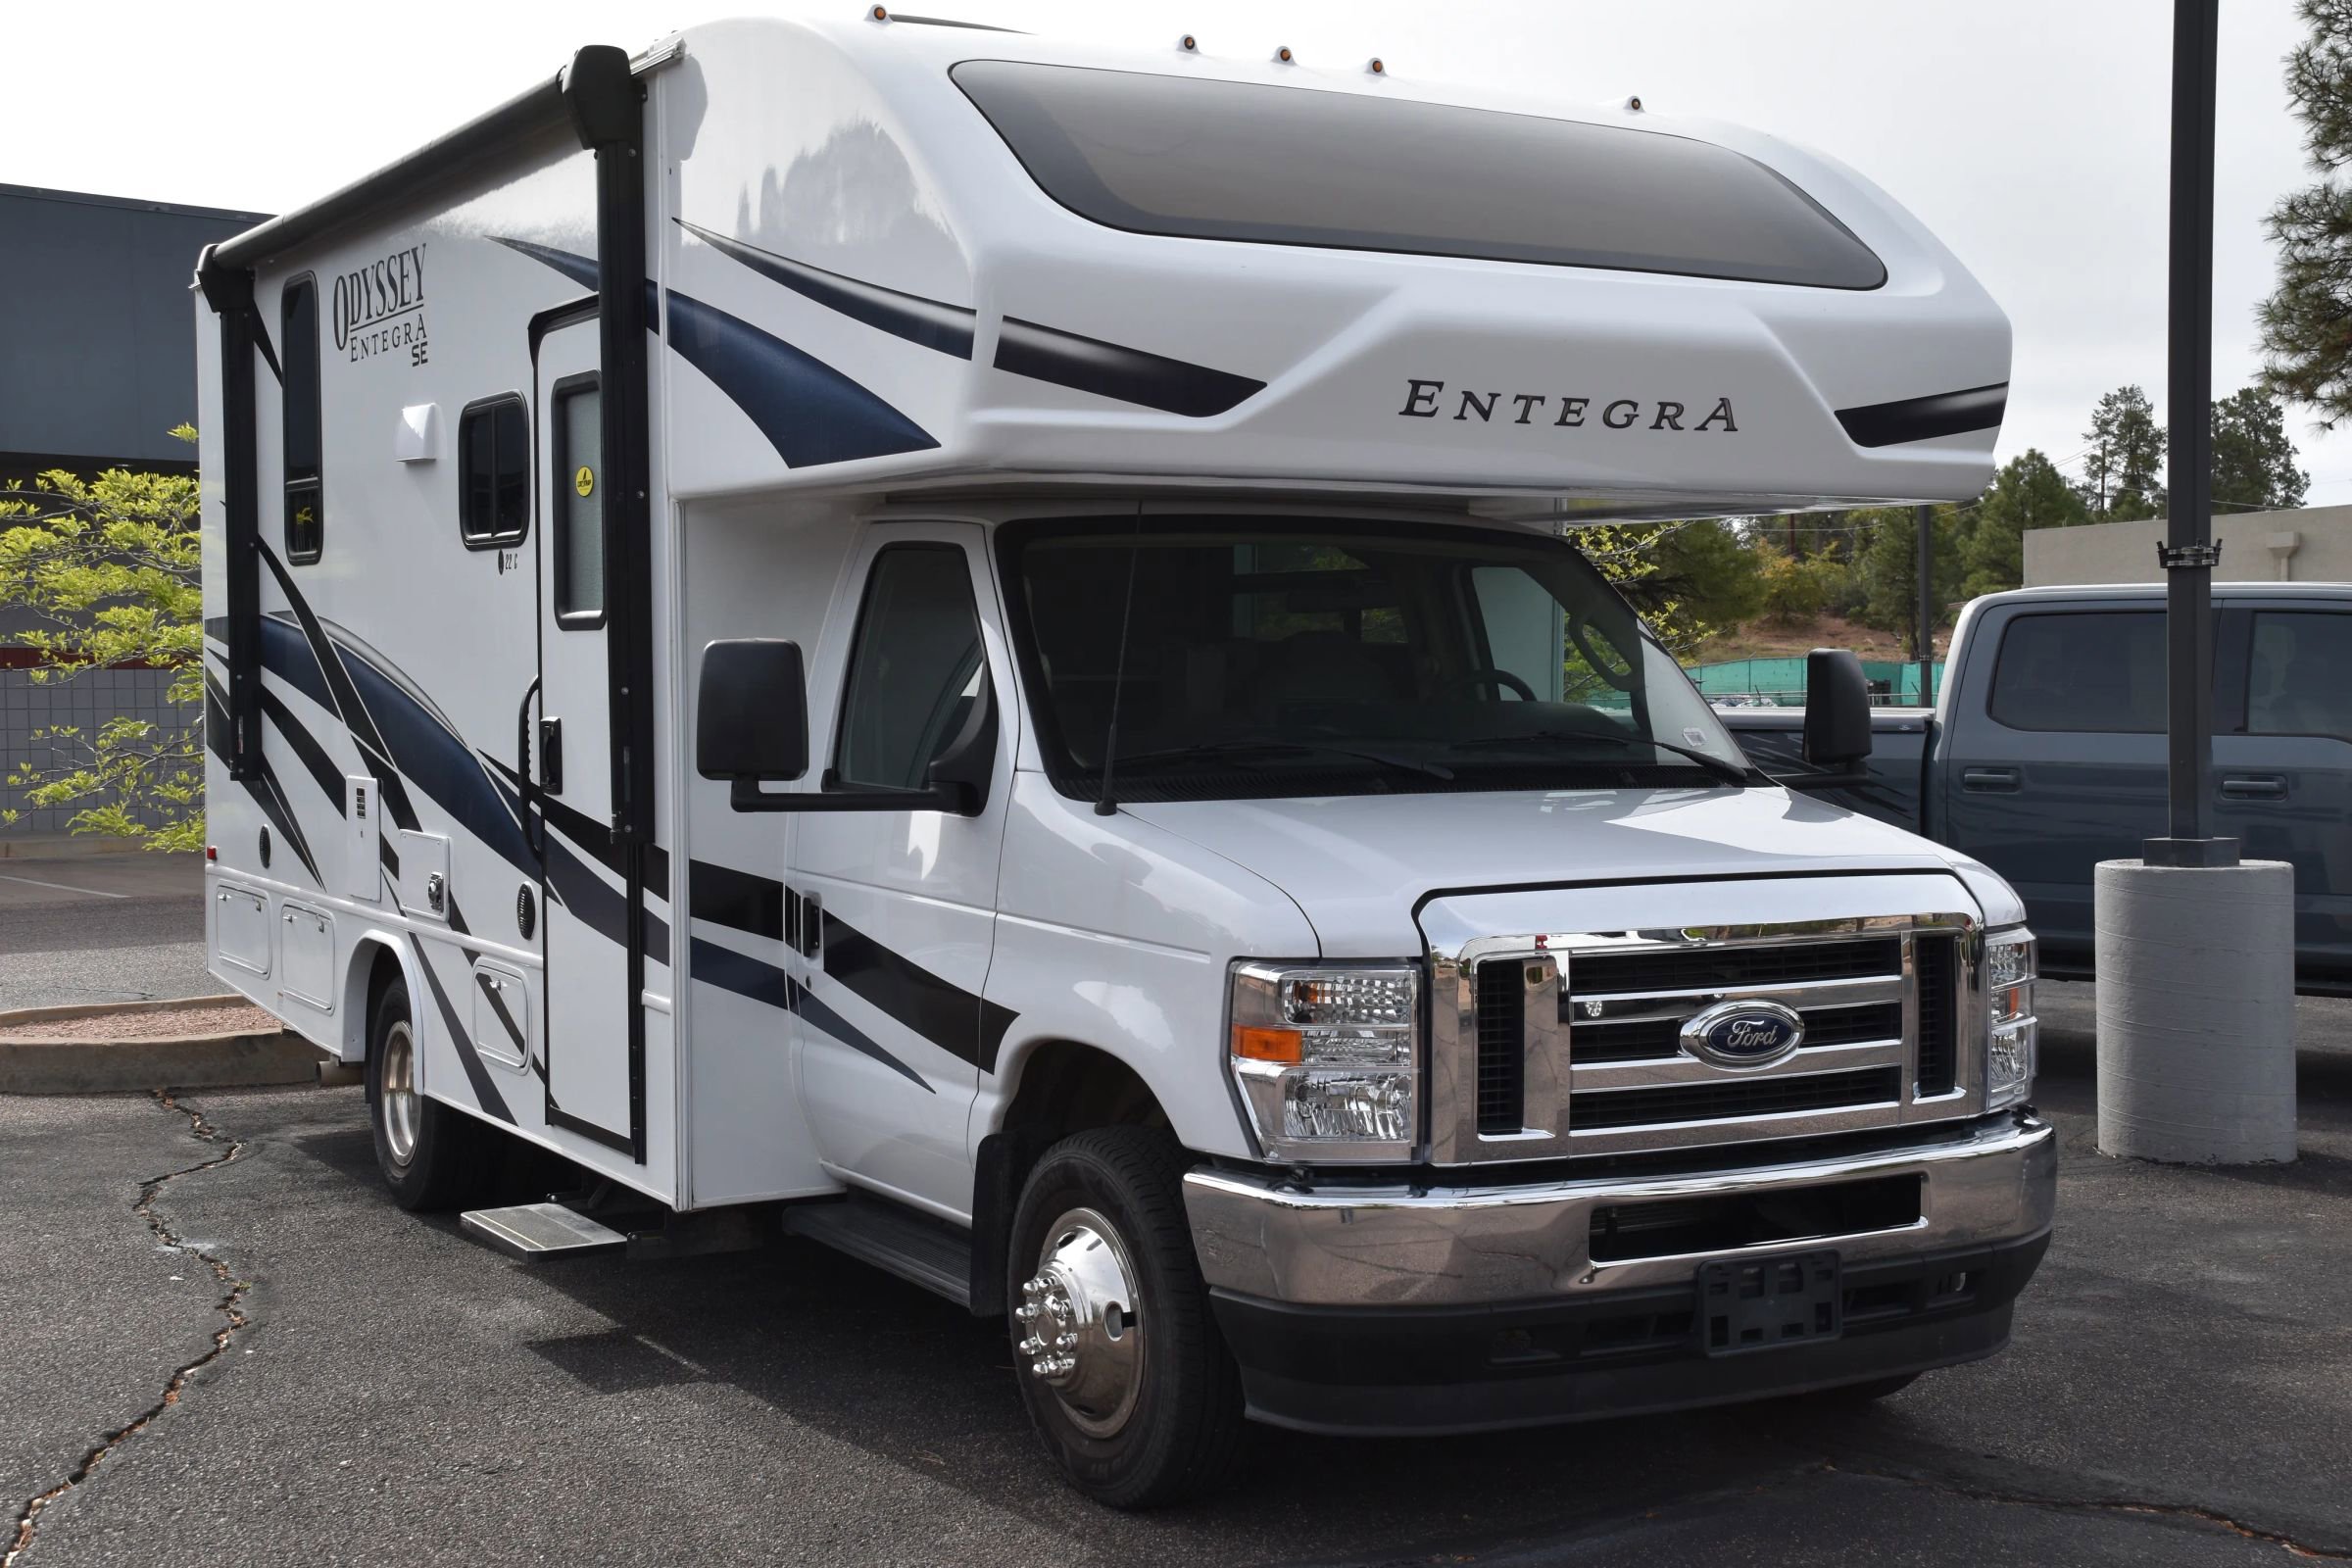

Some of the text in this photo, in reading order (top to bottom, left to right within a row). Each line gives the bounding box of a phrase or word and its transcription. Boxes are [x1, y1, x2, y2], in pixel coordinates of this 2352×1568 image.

[333, 242, 427, 352] ODYSSEY
[349, 313, 427, 363] ENTEGRA
[411, 340, 428, 368] SE
[1397, 378, 1740, 433] ENTEGRA
[1727, 1020, 1778, 1048] Ford
